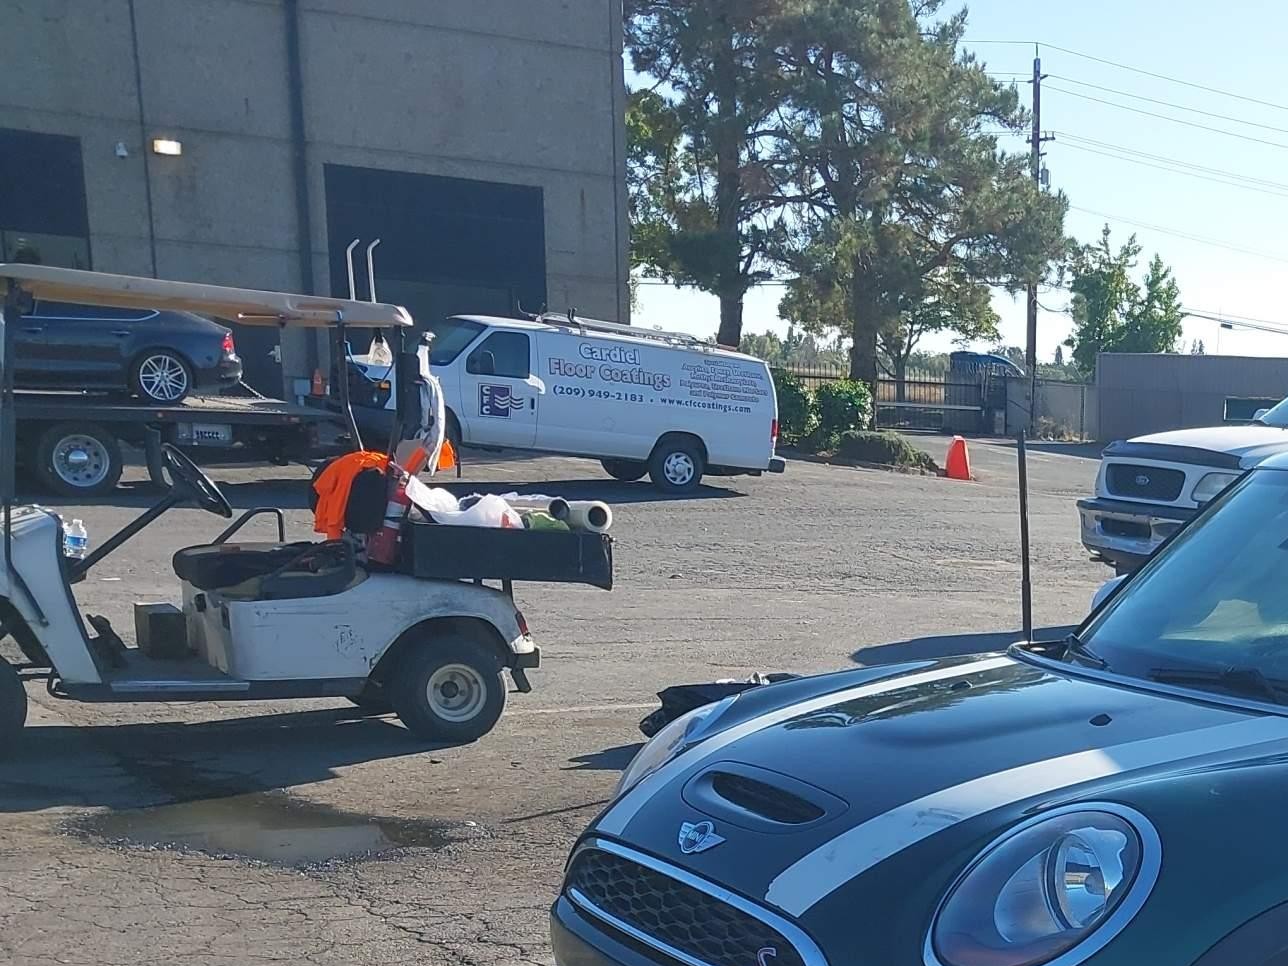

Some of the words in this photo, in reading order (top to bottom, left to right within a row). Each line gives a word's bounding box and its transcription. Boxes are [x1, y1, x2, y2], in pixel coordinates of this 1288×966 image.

[579, 342, 641, 365] Cardiel
[548, 358, 596, 379] Floor
[599, 364, 671, 391] Coatings
[553, 384, 586, 398] (209)
[588, 389, 644, 403] 949-2183
[660, 397, 751, 413] www.cfccoatings.com
